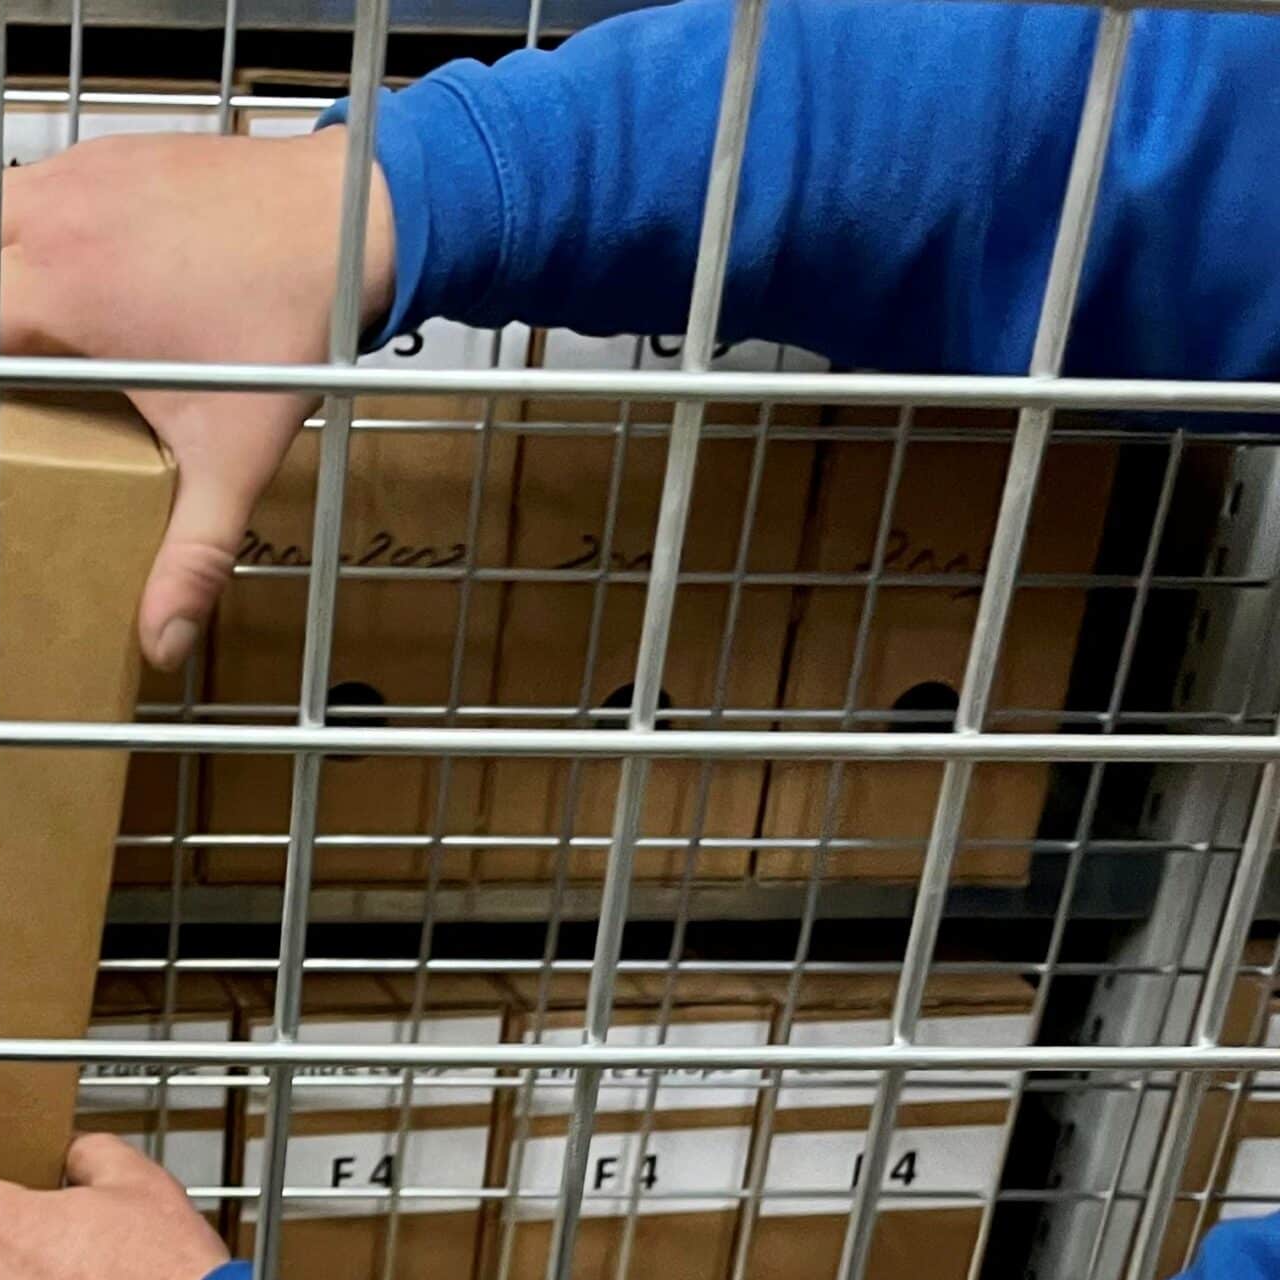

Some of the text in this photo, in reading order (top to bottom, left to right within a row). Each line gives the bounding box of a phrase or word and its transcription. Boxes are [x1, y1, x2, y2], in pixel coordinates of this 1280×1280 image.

[331, 1154, 396, 1188] F 4
[594, 1154, 658, 1190] F 4
[889, 1150, 917, 1187] 4
